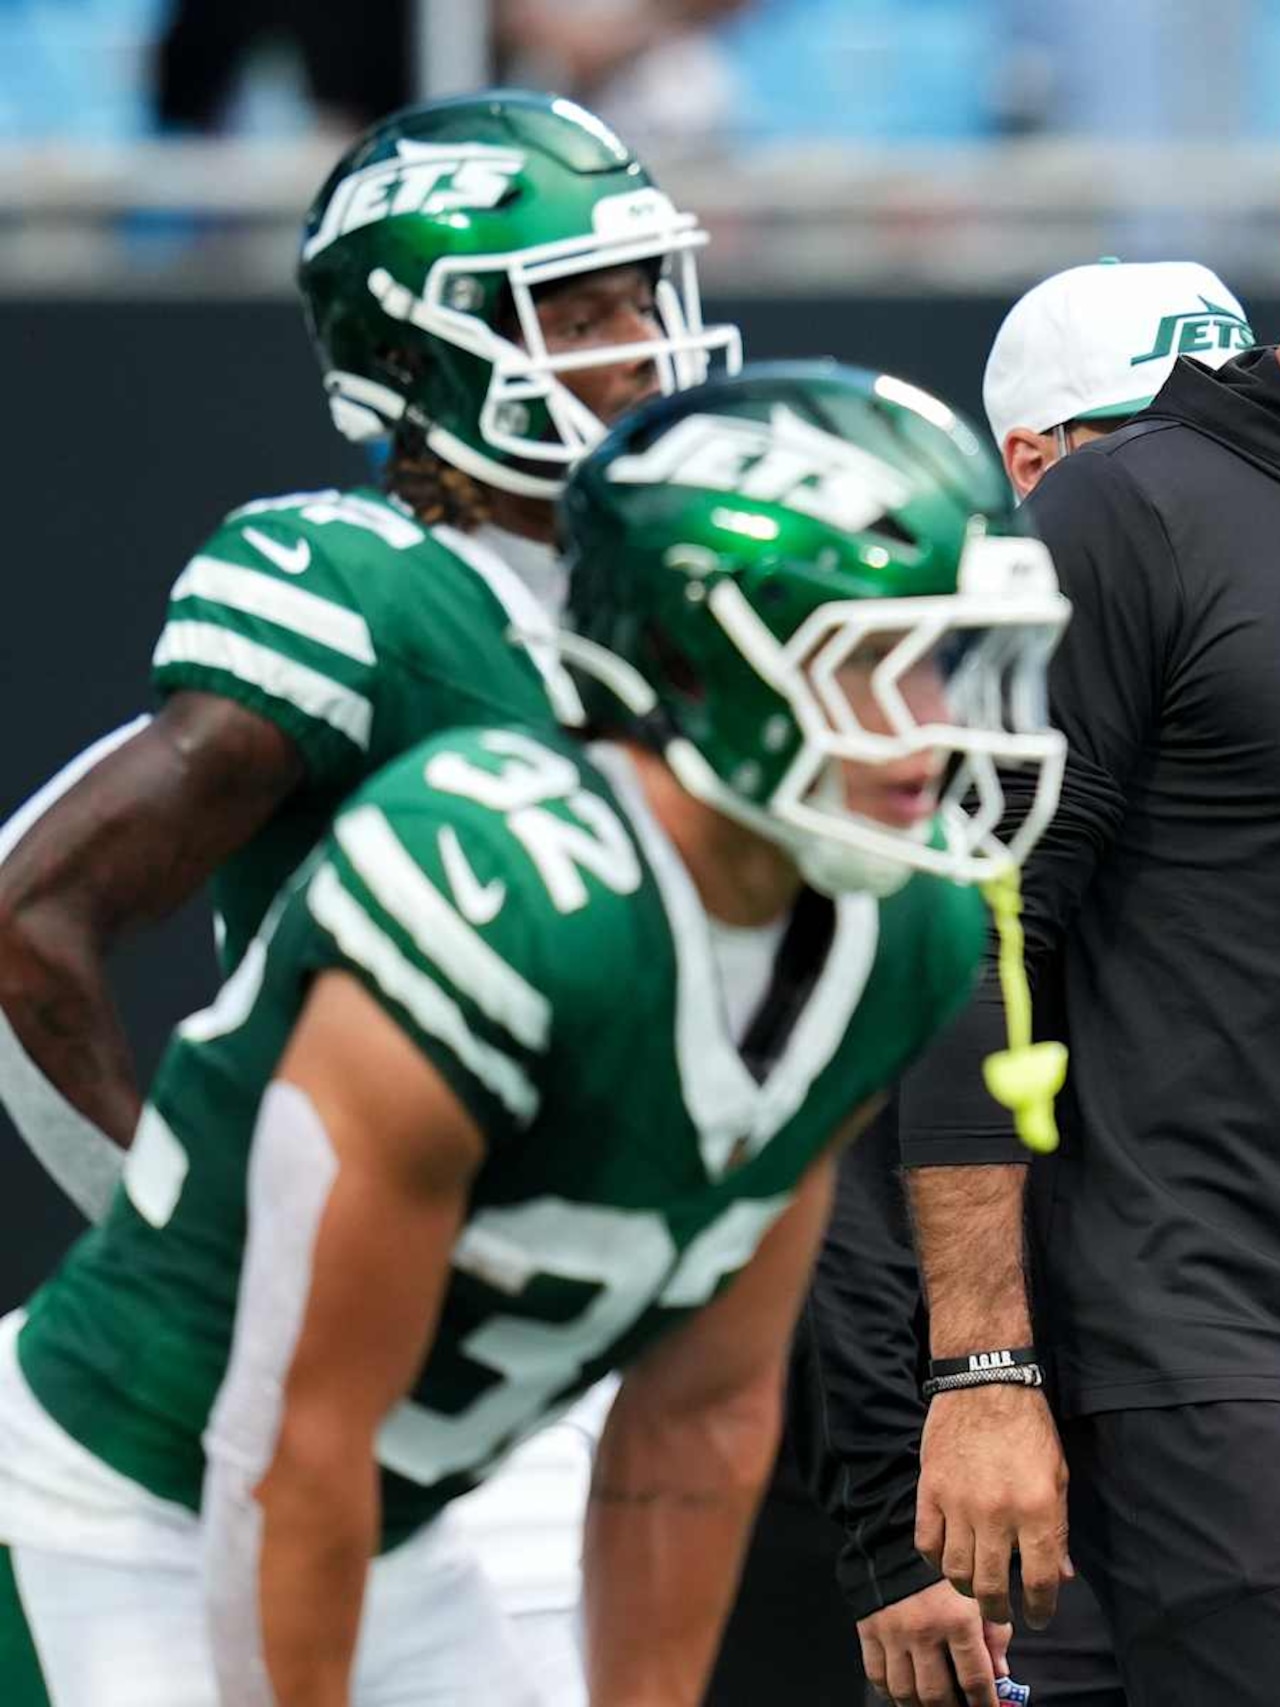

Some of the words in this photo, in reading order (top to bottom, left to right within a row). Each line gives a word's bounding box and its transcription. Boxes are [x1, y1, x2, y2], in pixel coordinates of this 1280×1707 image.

[303, 138, 524, 261] JETS
[1130, 294, 1256, 366] JETS
[605, 402, 908, 533] JETS
[424, 729, 642, 914] 32
